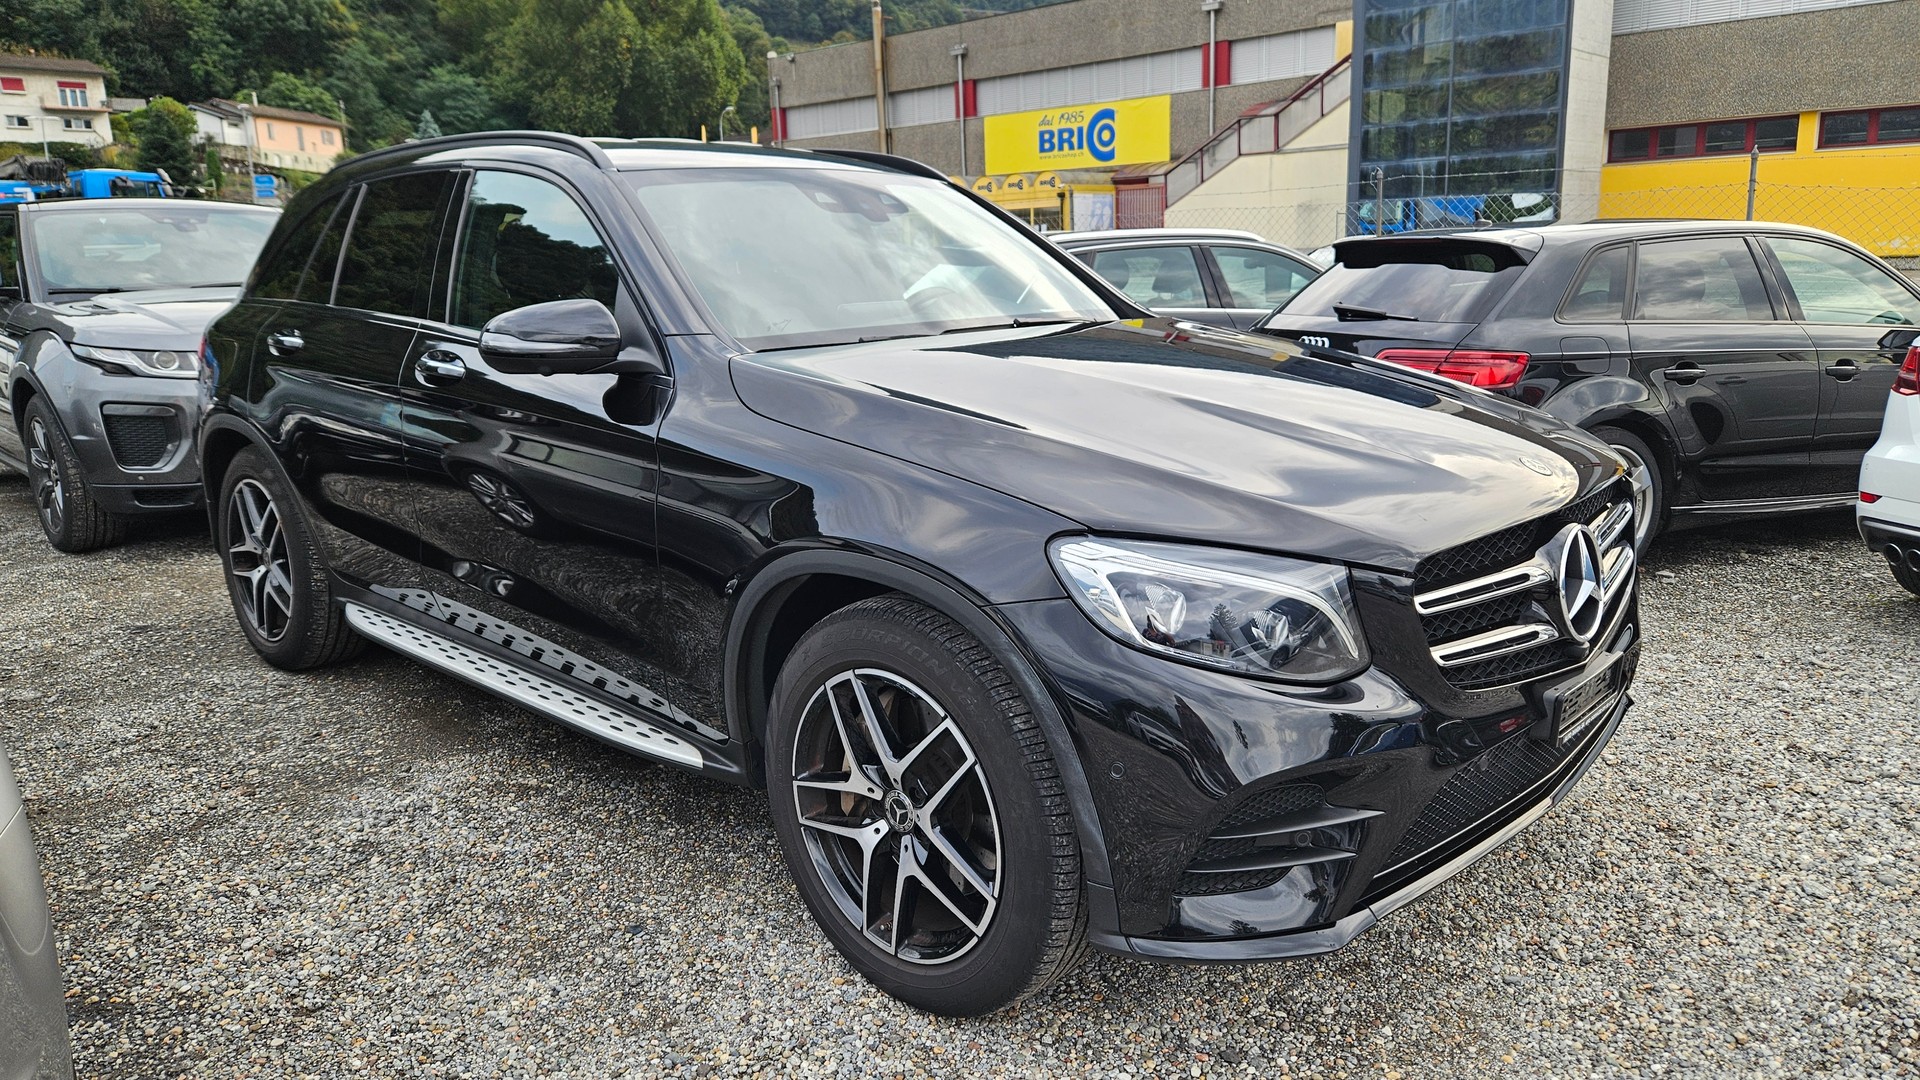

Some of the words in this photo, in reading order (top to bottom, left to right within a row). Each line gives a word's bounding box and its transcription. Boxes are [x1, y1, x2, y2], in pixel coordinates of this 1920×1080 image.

[1038, 114, 1054, 127] dal
[1058, 110, 1084, 125] 1985
[1038, 107, 1115, 162] BRICO
[822, 625, 949, 676] SCORPION
